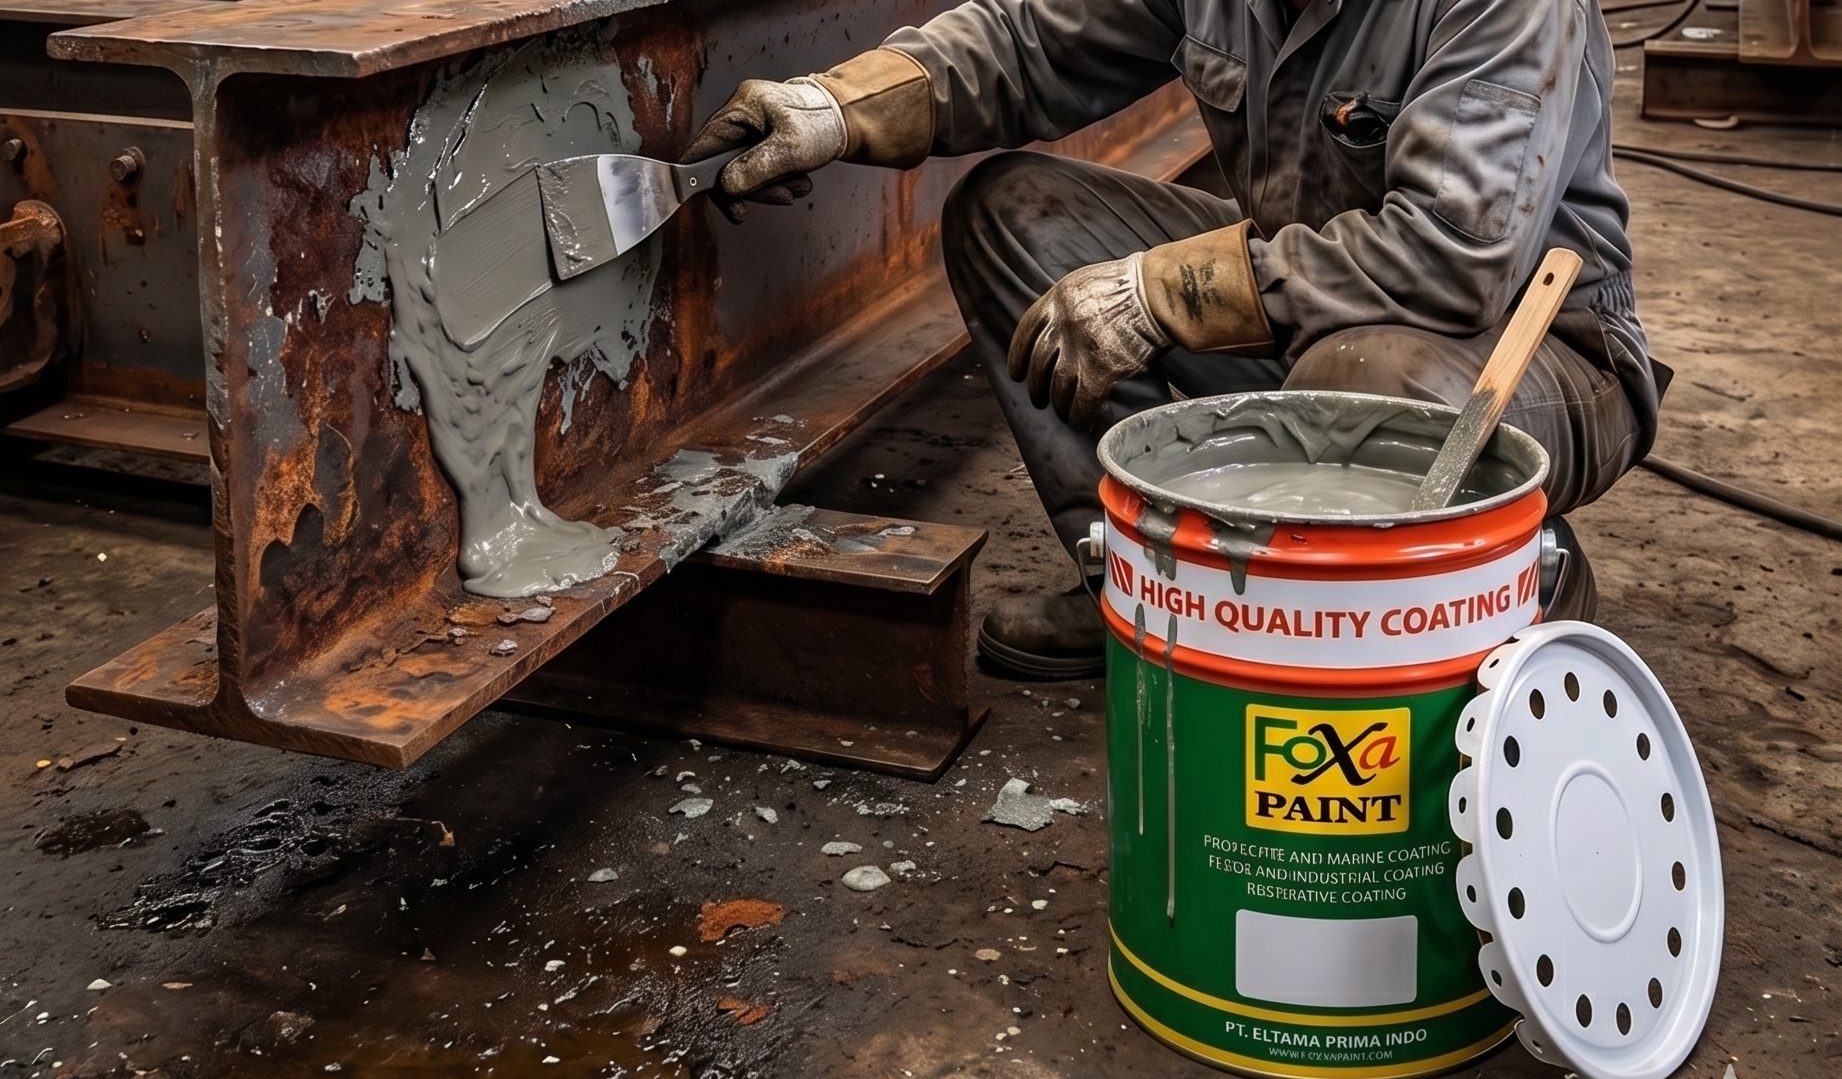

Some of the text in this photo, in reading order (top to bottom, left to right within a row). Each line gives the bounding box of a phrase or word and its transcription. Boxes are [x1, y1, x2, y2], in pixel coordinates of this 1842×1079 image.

[1140, 575, 1511, 639] HIGH QUALITY COATING
[1254, 790, 1402, 824] PAINT
[1327, 851, 1384, 865] MARINE
[1255, 865, 1288, 881] AND
[1383, 861, 1444, 882] COATING
[1341, 887, 1406, 904] COATING
[1225, 1021, 1427, 1049] PT. ELTAMA PRIMA INDO
